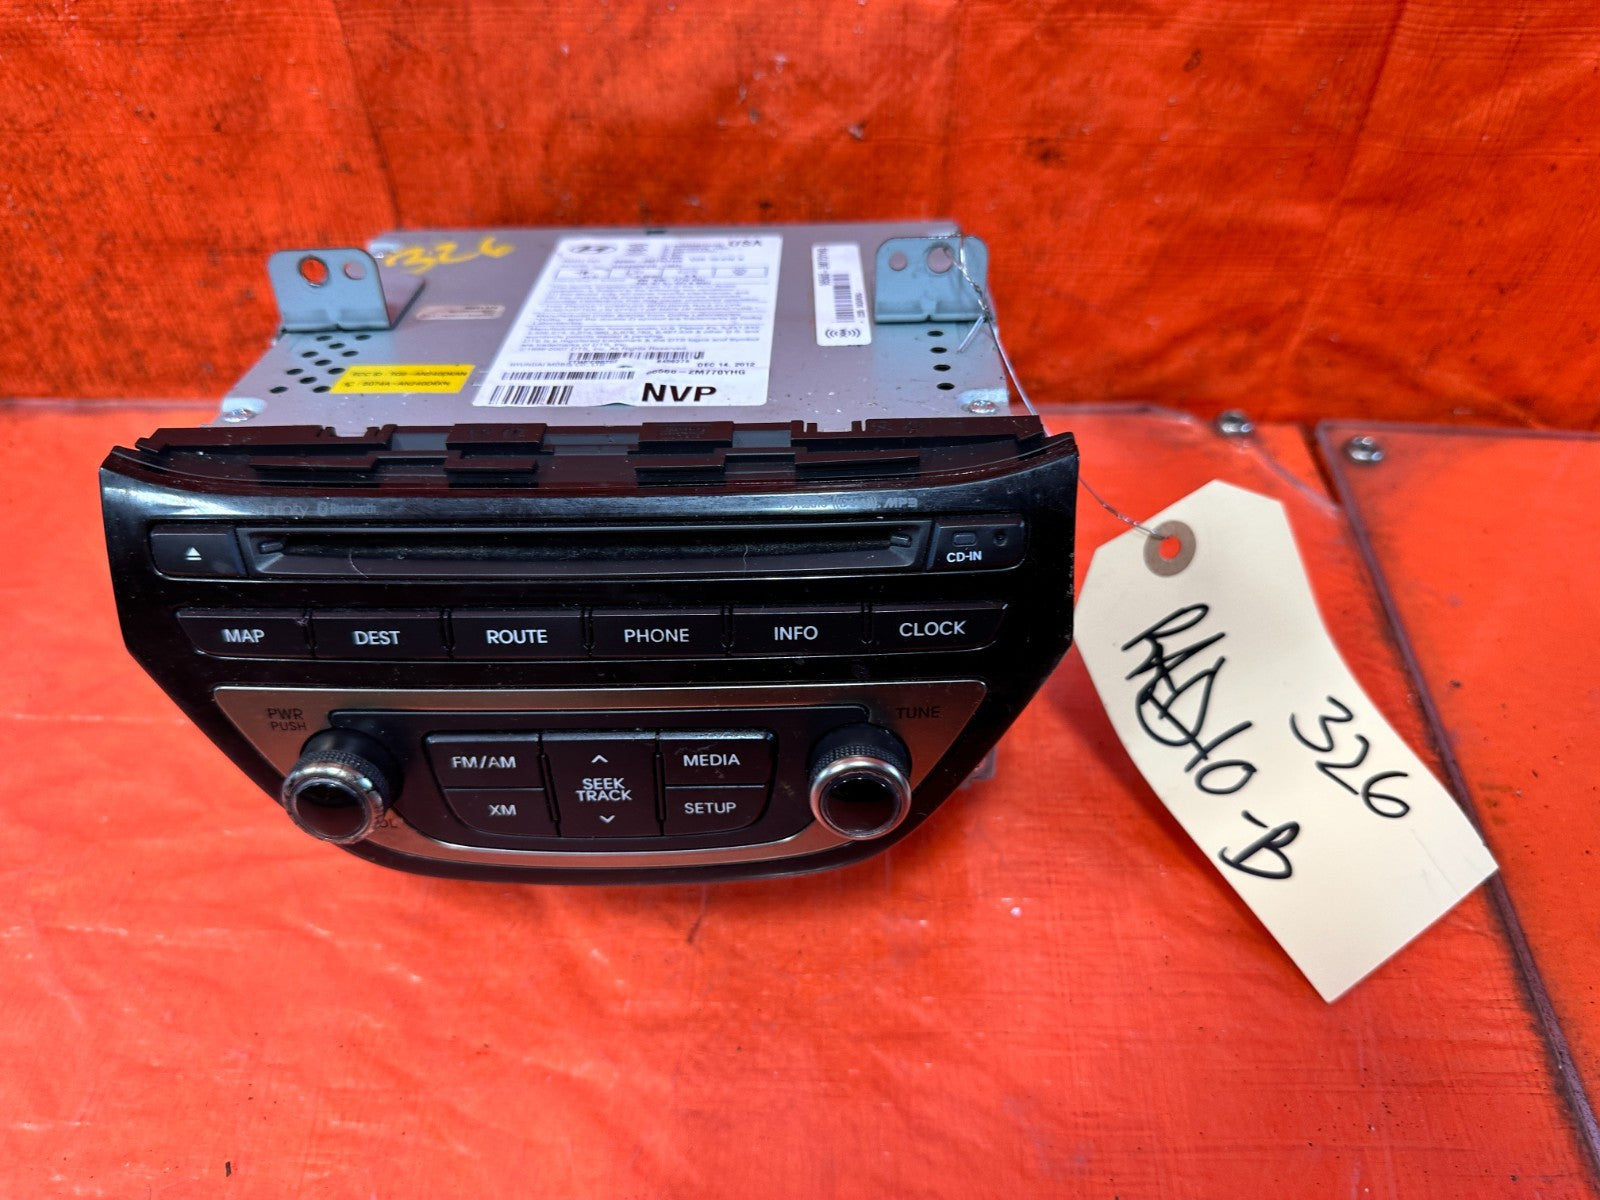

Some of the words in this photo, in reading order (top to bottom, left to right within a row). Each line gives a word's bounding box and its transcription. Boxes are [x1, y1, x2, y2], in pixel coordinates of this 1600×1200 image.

[641, 382, 717, 402] NVP
[946, 550, 982, 563] CD-IN
[774, 625, 819, 641] INFO
[899, 620, 966, 637] CLOCK
[220, 629, 265, 643] MAP
[353, 630, 400, 646] DEST
[486, 629, 548, 644] ROUTE
[623, 628, 690, 643] PHONE
[267, 708, 304, 720] PWR
[896, 706, 941, 719] TUNE
[271, 721, 307, 731] PUSH
[451, 756, 517, 769] FM/AM
[683, 753, 741, 767] MEDIA
[1288, 695, 1411, 818] 326
[582, 777, 625, 790] SEEK
[576, 789, 632, 802] TRACK
[489, 804, 517, 816] XM
[684, 802, 737, 815] SETUP
[377, 817, 399, 829] OL
